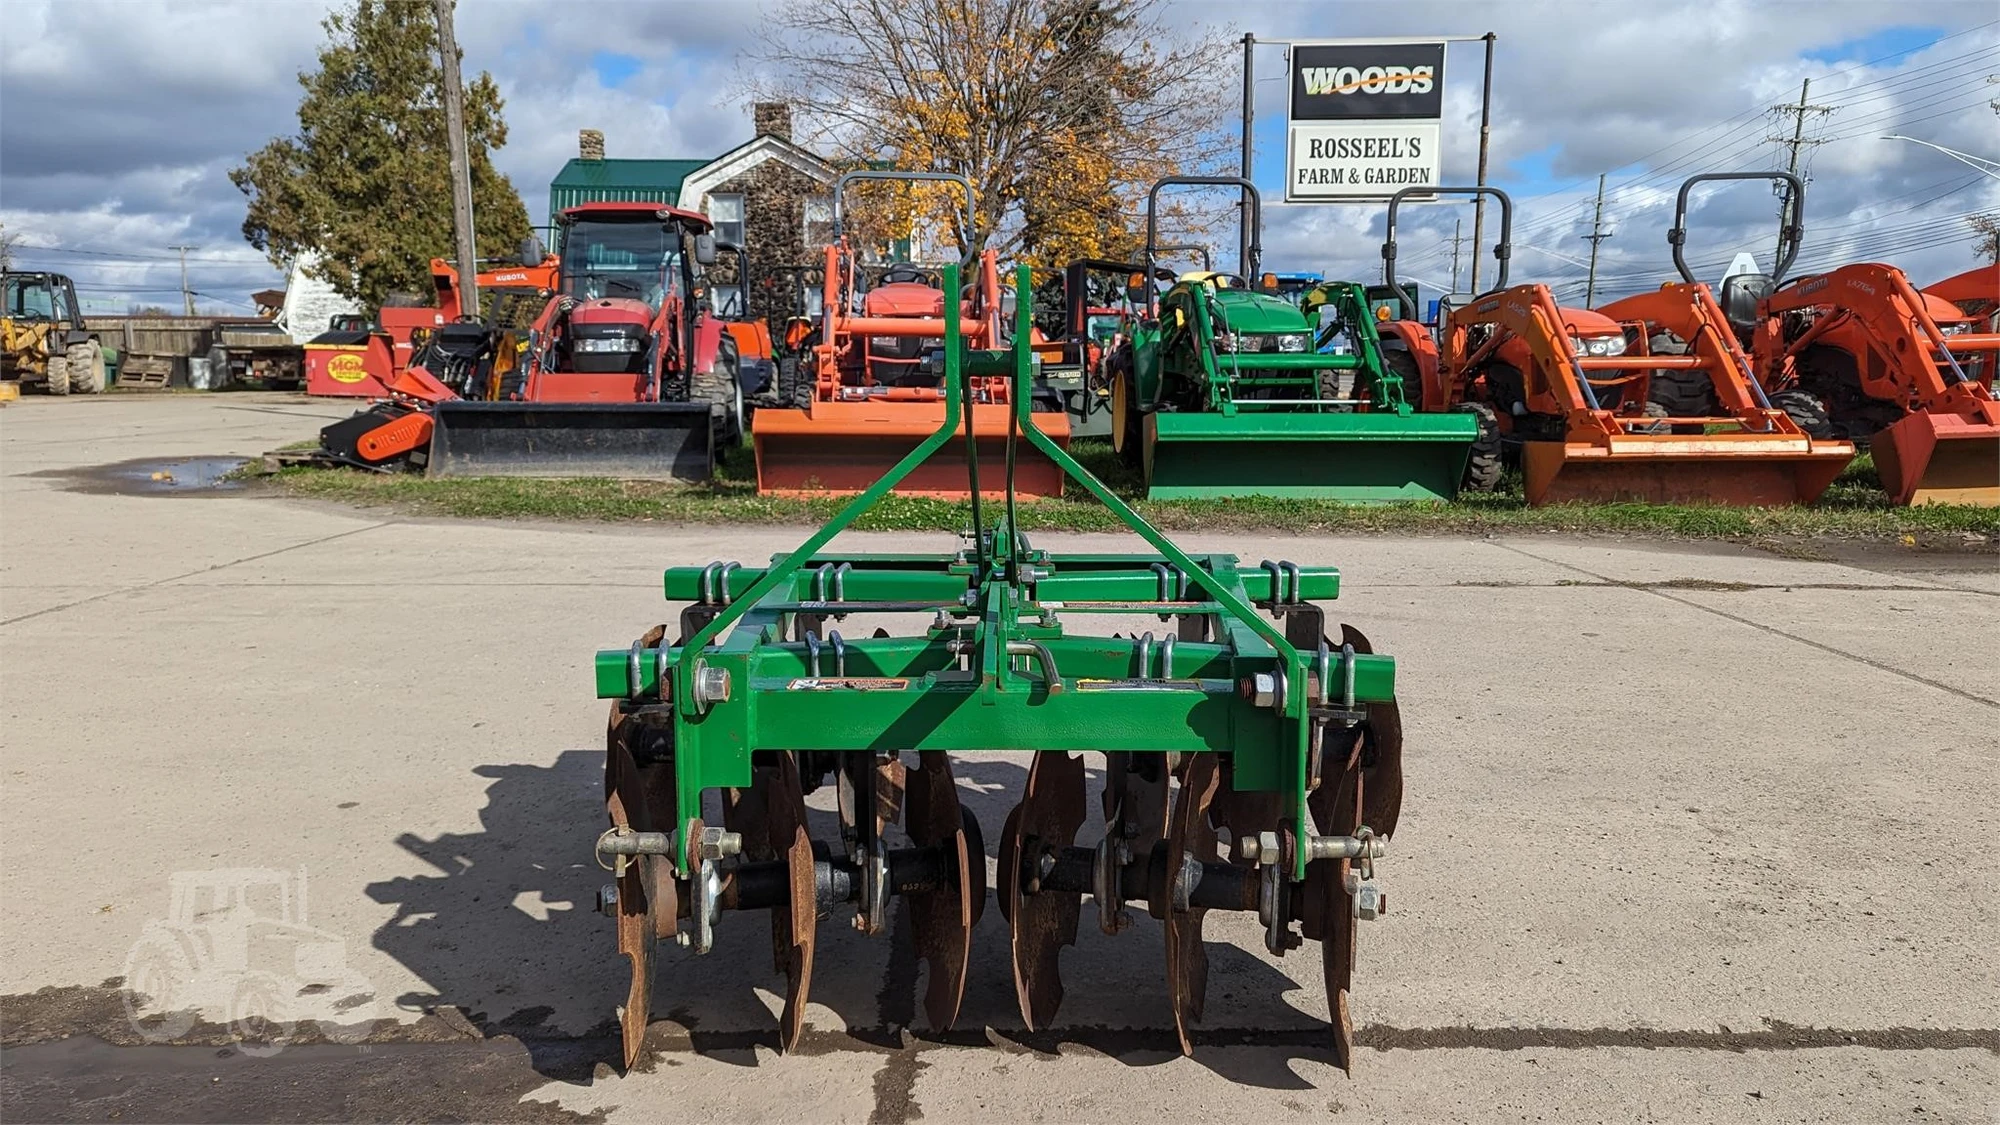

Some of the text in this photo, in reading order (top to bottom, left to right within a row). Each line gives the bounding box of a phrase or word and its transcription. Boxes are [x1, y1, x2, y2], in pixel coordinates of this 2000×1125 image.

[1302, 66, 1433, 95] WOODS
[1309, 137, 1421, 159] ROSSEEL'S
[1298, 167, 1430, 184] FARM & GARDEN
[495, 273, 528, 281] KUBOTA
